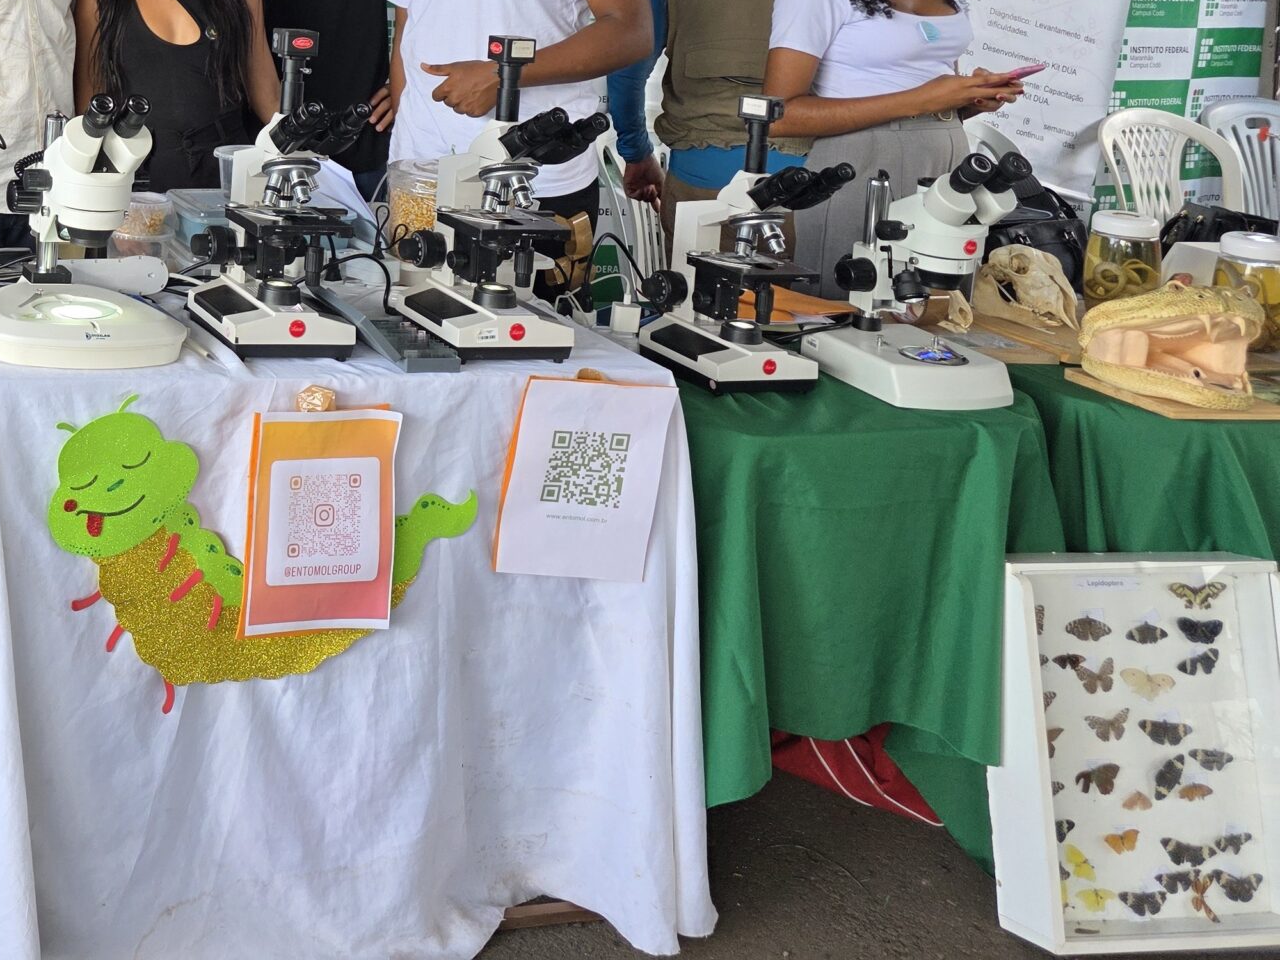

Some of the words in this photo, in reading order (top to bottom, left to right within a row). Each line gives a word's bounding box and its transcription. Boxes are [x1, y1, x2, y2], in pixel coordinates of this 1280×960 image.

[1035, 20, 1081, 40] Levantamento
[1084, 35, 1096, 45] das
[1130, 46, 1163, 54] INSTITUTO
[1164, 46, 1189, 54] FEDERAL
[982, 42, 1041, 66] Desenvolvimento
[1051, 61, 1061, 71] Kit
[1061, 65, 1078, 76] DUA
[1127, 97, 1160, 106] INSTITUTO
[1160, 97, 1182, 105] FEDERAL
[284, 563, 362, 578] @ENTOMOLGROUP
